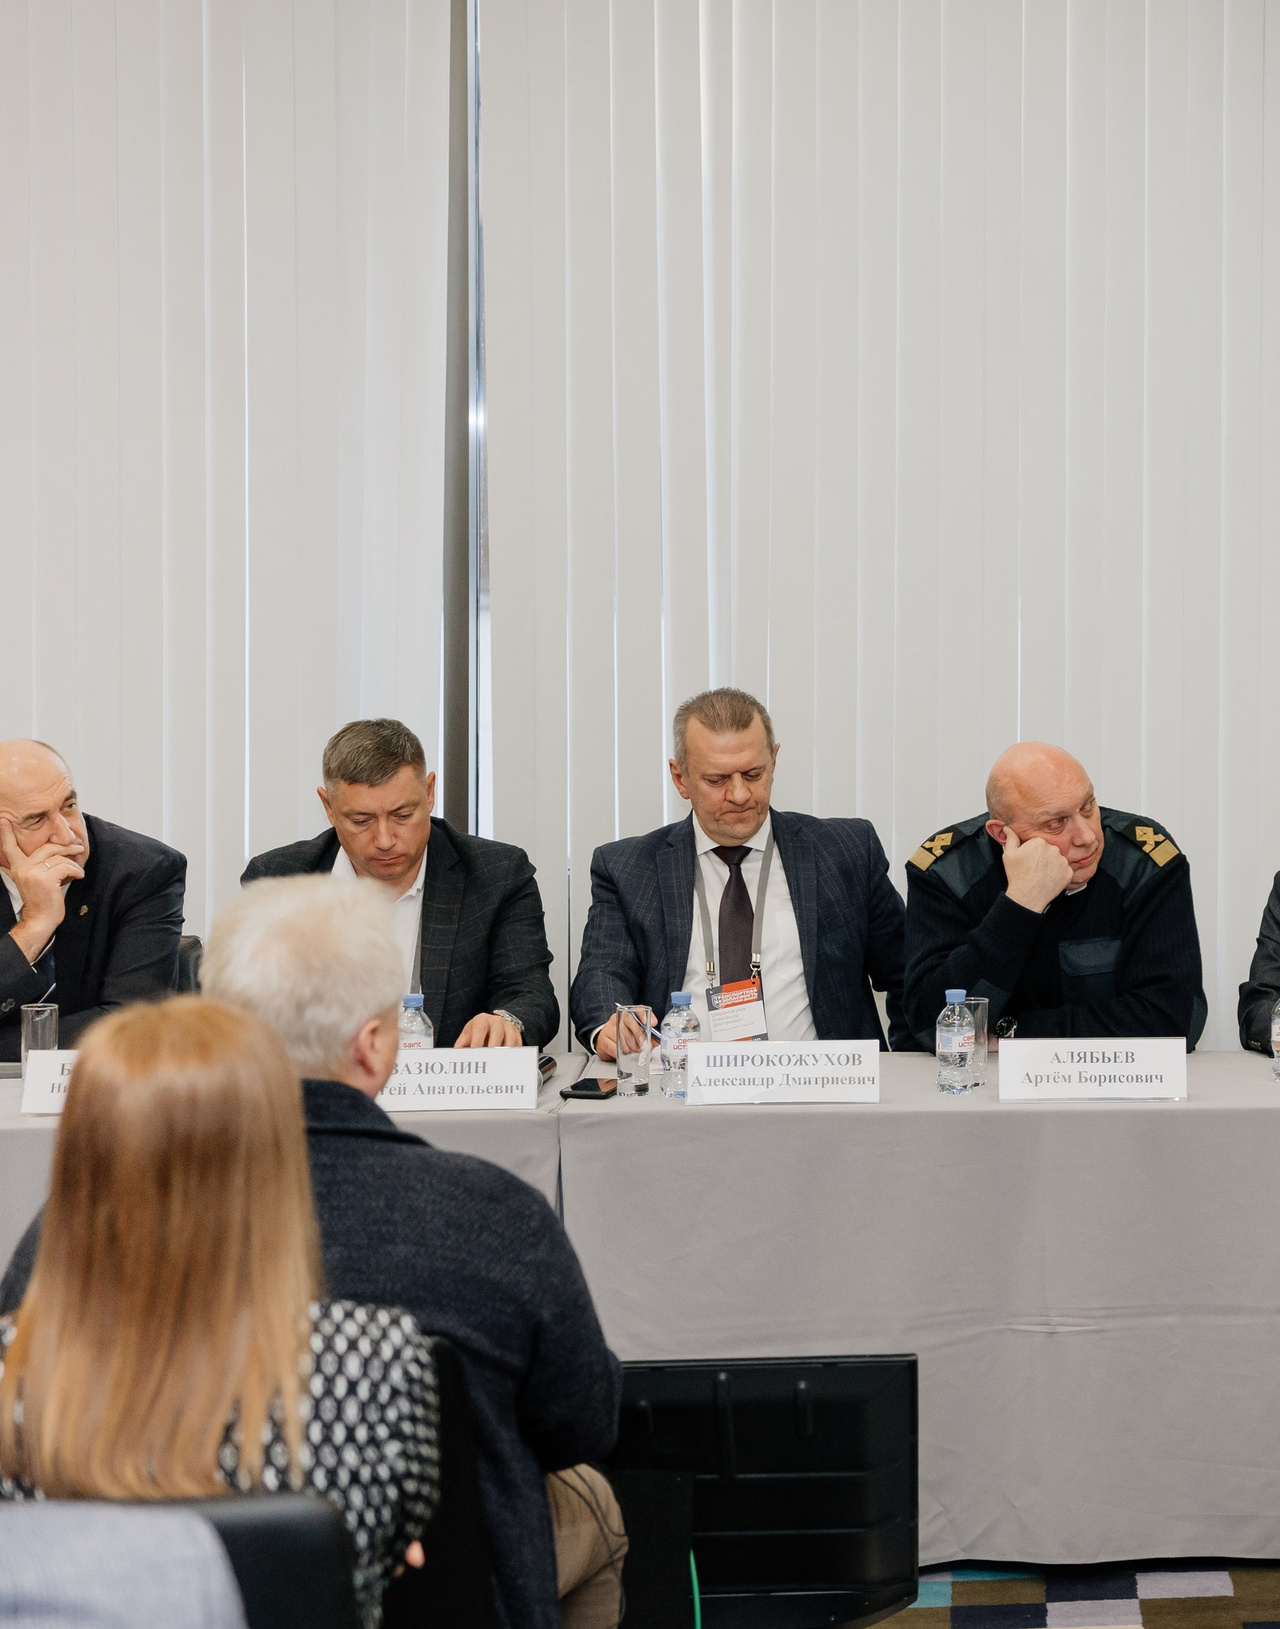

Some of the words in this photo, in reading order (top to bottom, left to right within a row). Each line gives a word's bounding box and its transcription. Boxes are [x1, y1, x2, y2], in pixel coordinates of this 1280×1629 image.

[705, 1053, 863, 1068] ШИРОКОЖУХОВ
[1050, 1051, 1136, 1064] АЛЯБЬЕВ
[691, 1075, 774, 1089] Александр
[779, 1073, 876, 1088] Дмитриевич
[1021, 1071, 1072, 1087] Артём
[1078, 1071, 1164, 1087] Борисович
[380, 1083, 406, 1095] гей
[412, 1083, 525, 1096] Анатольевич
